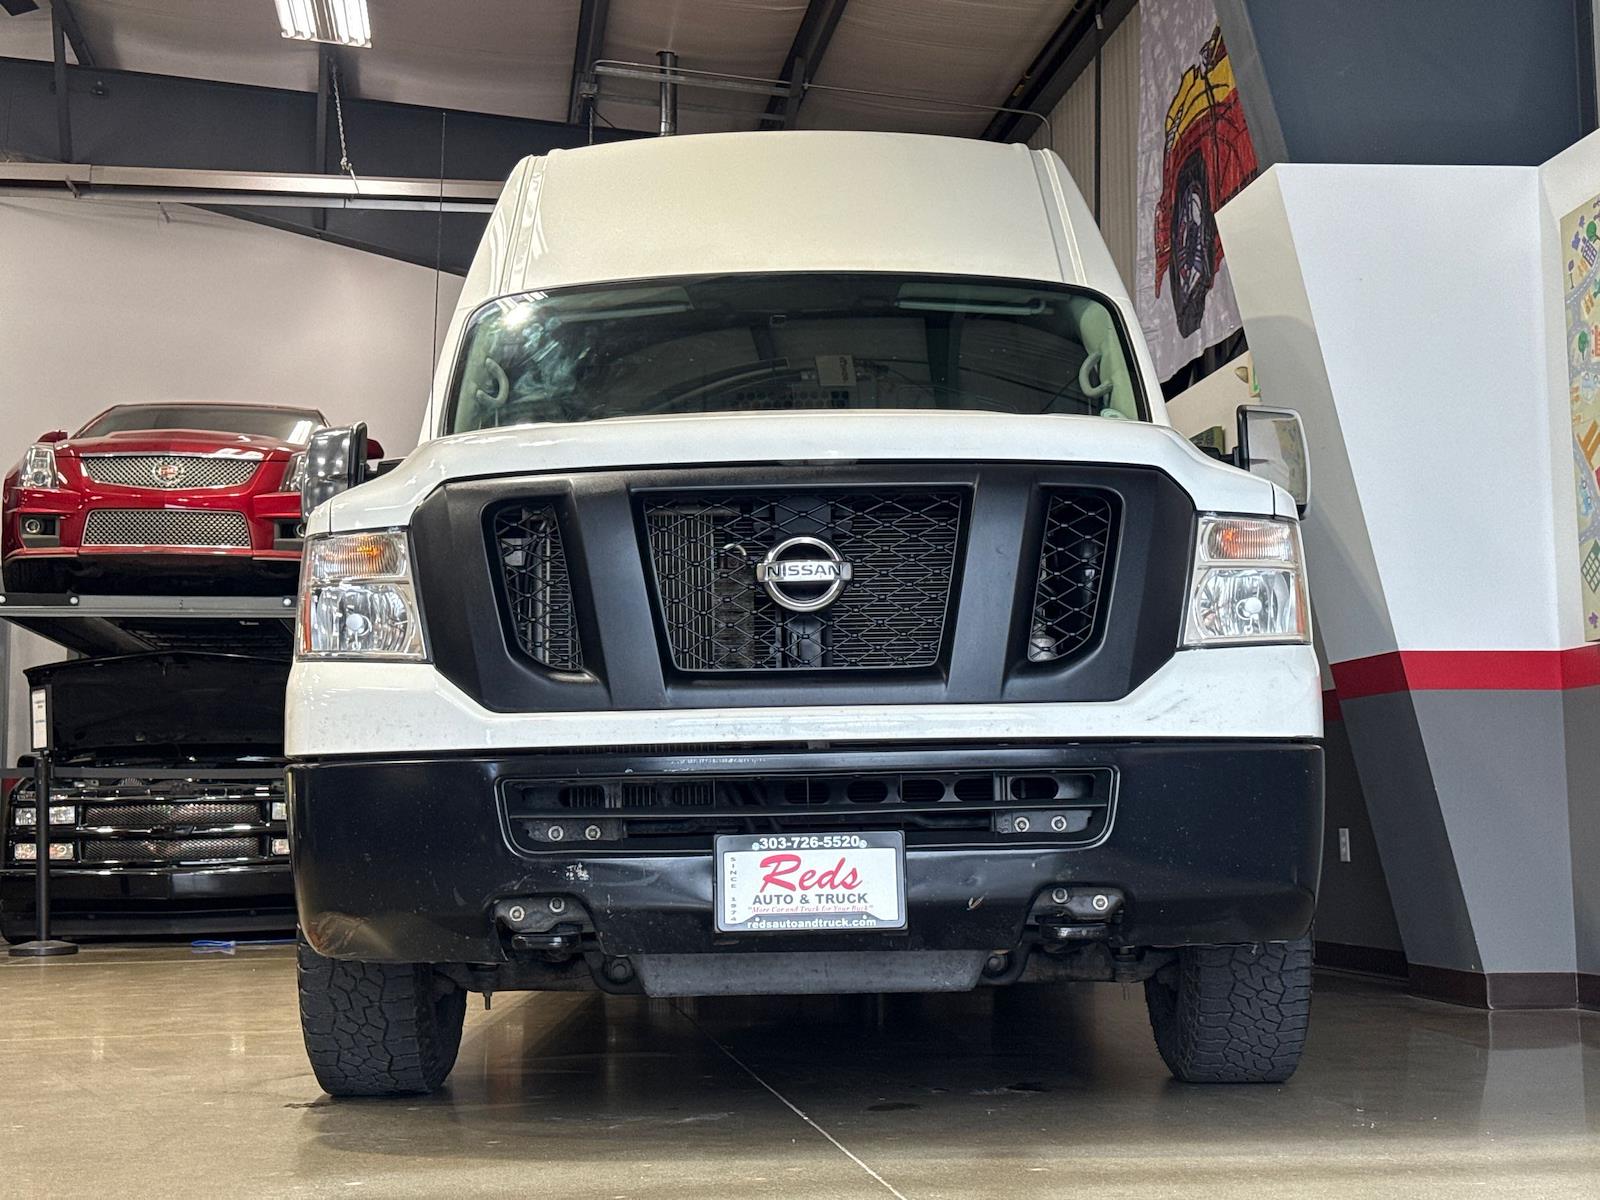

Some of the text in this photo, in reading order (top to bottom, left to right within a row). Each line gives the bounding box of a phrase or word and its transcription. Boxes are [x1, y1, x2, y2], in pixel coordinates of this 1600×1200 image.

[767, 564, 841, 577] NISSAN
[759, 836, 860, 849] 303-726-5520
[760, 854, 863, 893] Reds
[753, 892, 868, 905] AUTO & TRUCK
[747, 918, 877, 929] redsautoandtruck.com
